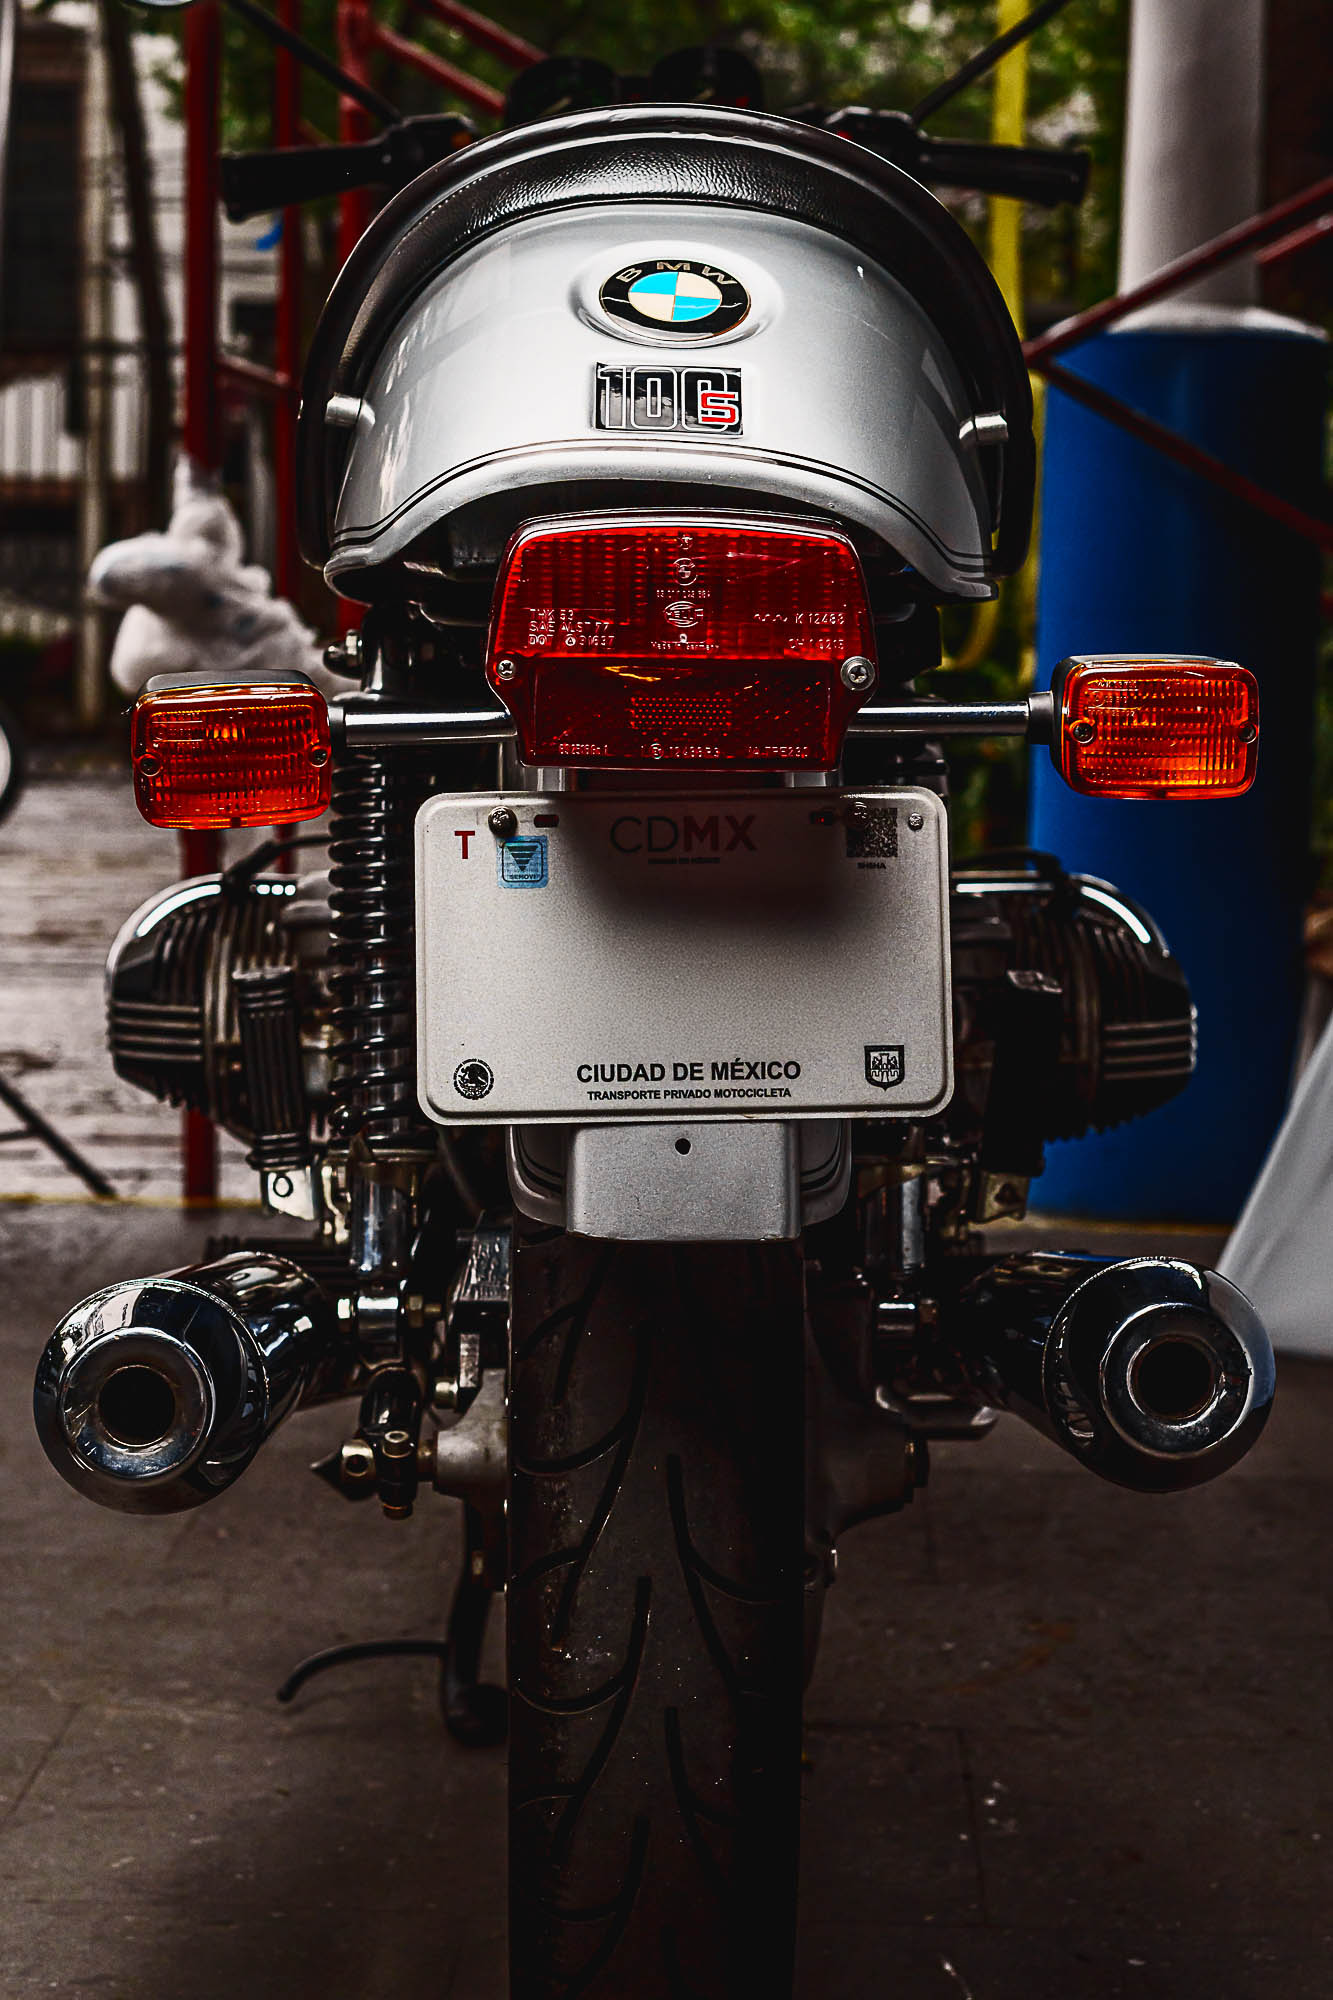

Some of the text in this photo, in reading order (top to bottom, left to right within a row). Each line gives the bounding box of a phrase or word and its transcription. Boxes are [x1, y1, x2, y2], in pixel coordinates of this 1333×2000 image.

[616, 261, 738, 286] BMW
[529, 620, 556, 632] SAE
[528, 633, 554, 645] DOT
[454, 830, 475, 859] T
[609, 815, 758, 855] CDMX
[576, 1057, 801, 1083] CIUDAD DE MÉXICO
[587, 1087, 792, 1101] TRANSPORTE PRIVADO MOTOCICLETA
